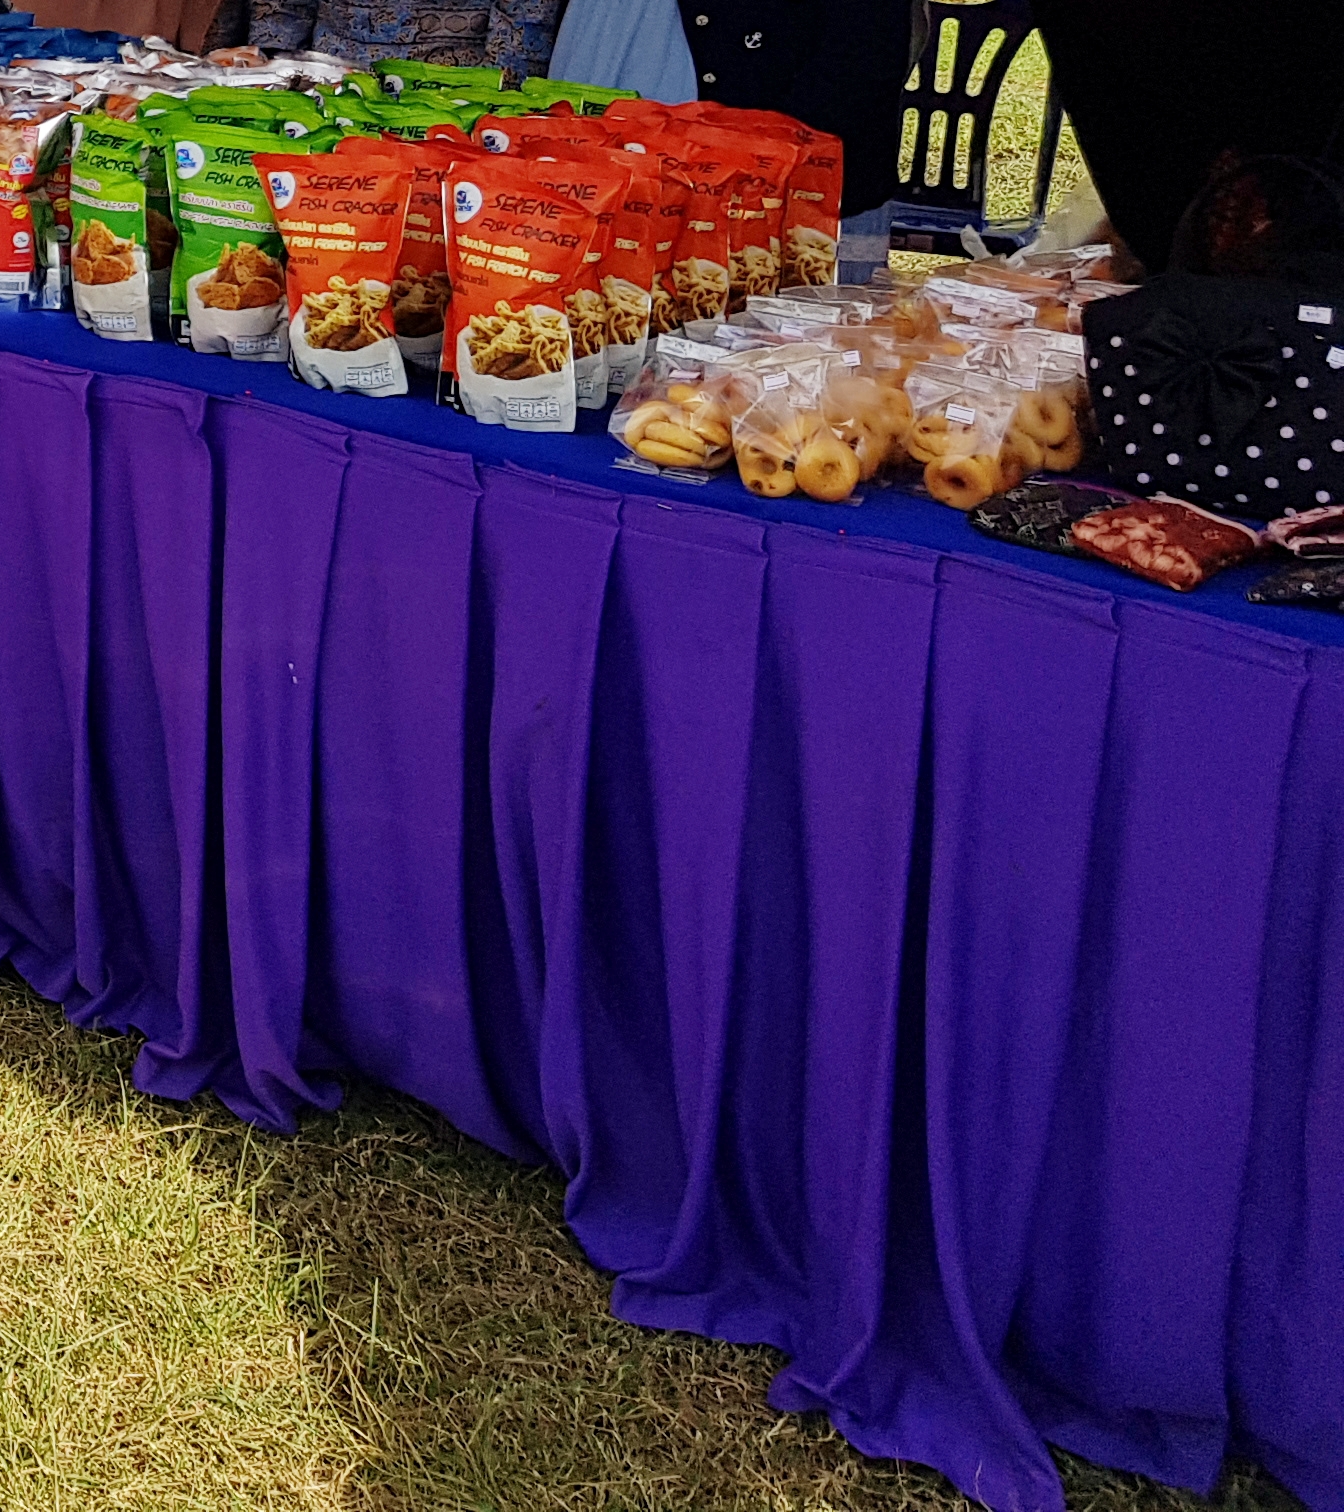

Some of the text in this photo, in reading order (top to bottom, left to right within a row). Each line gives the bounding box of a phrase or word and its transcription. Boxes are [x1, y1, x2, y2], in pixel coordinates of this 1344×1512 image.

[205, 171, 233, 186] FISH
[301, 173, 379, 192] SERENE
[299, 197, 399, 216] FISH CRACKER
[488, 193, 566, 219] SERENE
[479, 217, 580, 250] FISH CRACKER
